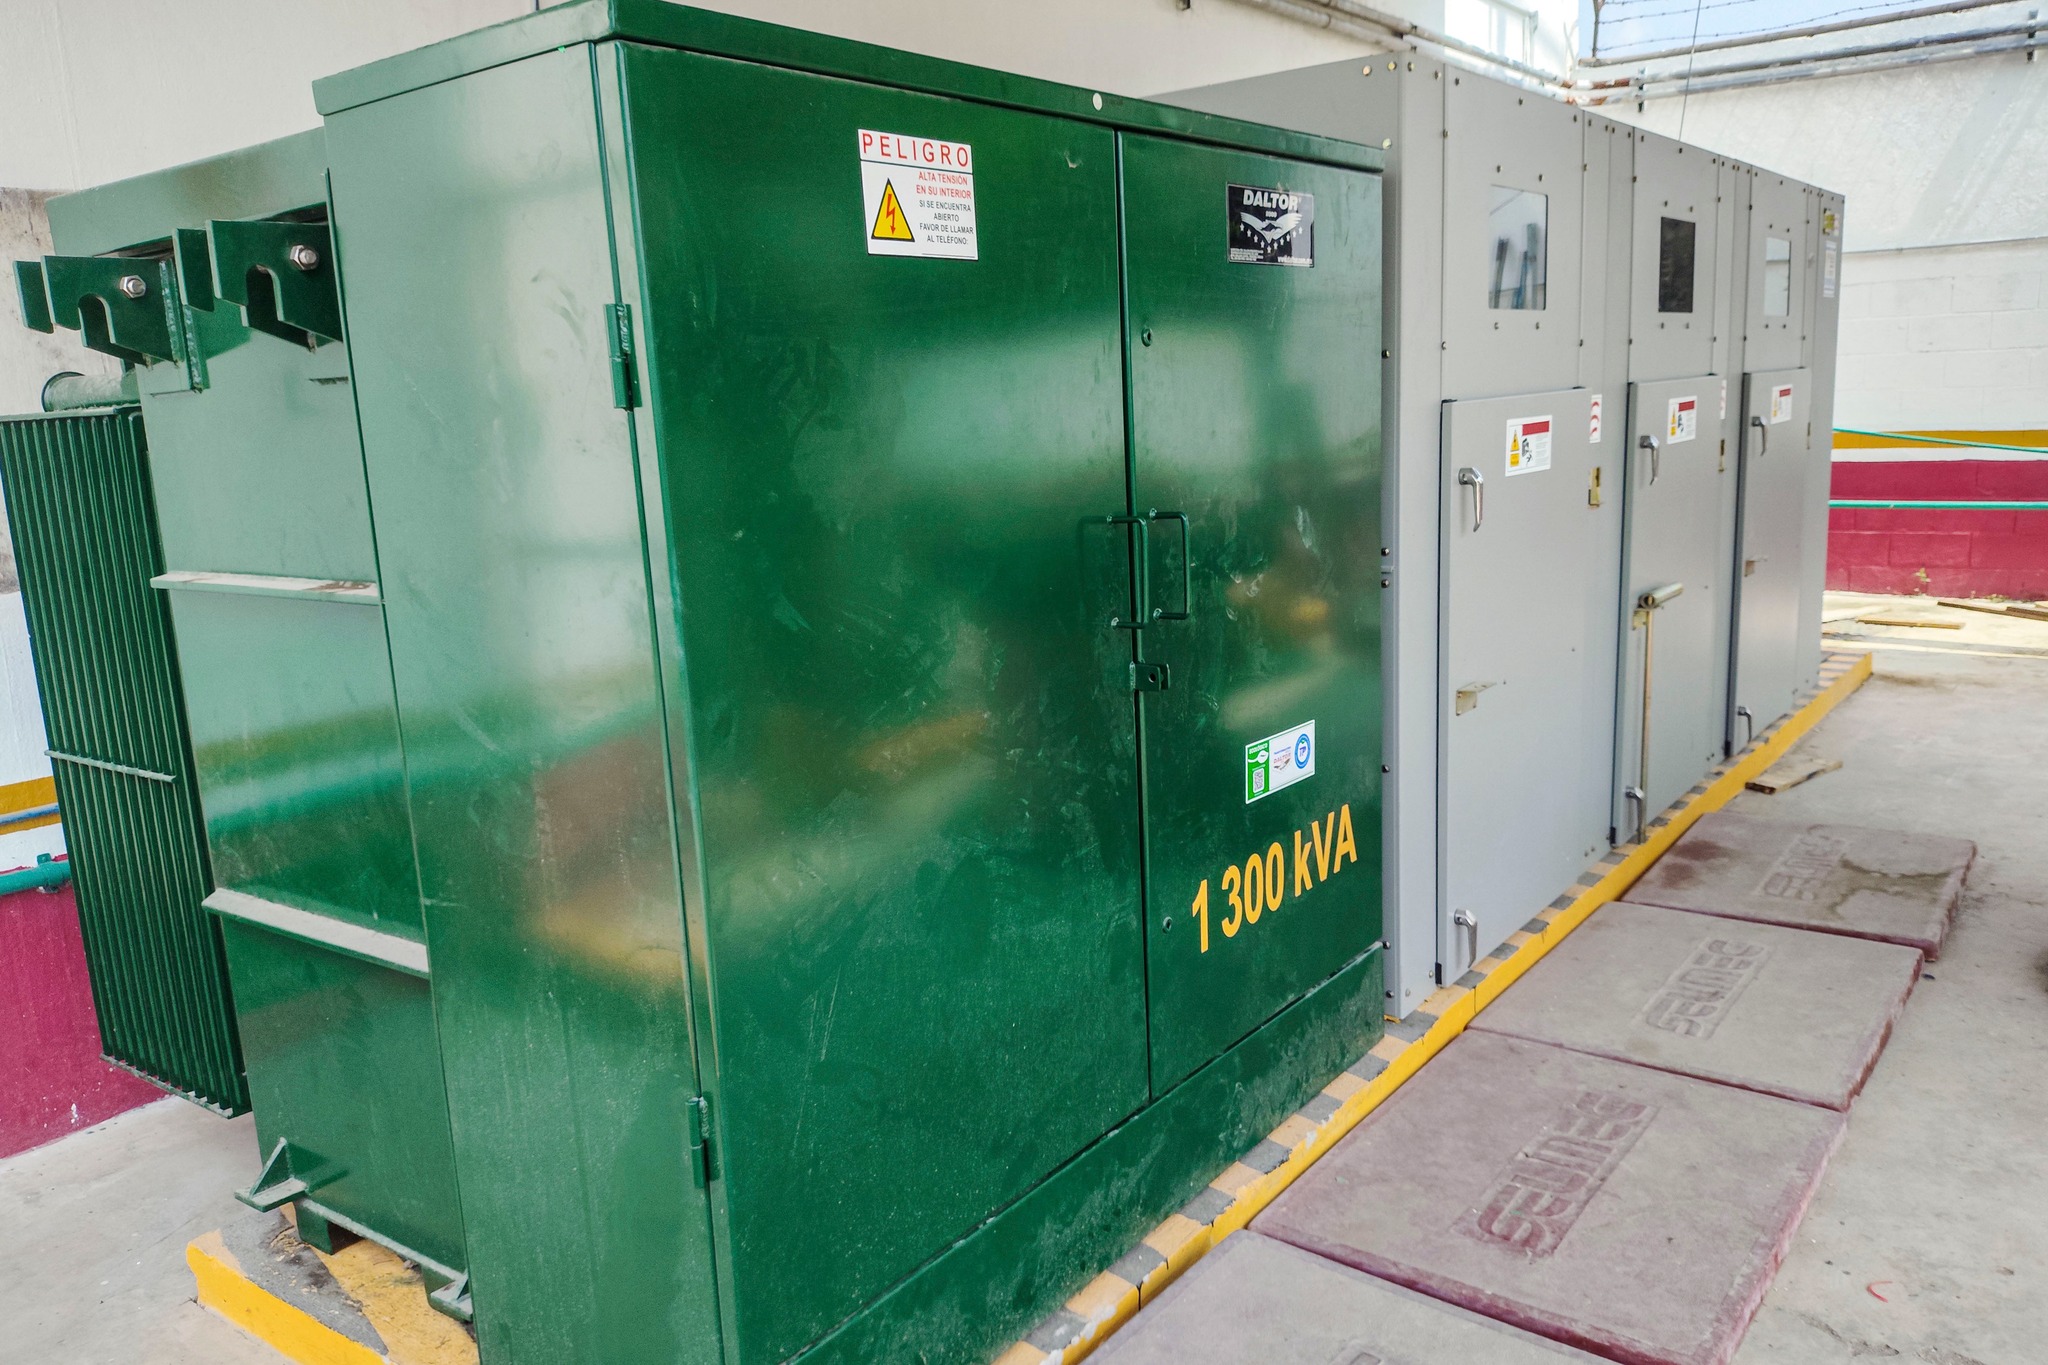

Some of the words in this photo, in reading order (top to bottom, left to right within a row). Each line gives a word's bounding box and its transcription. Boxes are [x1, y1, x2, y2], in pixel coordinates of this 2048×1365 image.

[862, 133, 969, 167] PELIGRO
[918, 171, 936, 181] ALTA
[937, 173, 968, 185] TENSIÓN
[916, 184, 927, 195] EN
[928, 186, 938, 196] SU
[939, 187, 972, 199] INTERIOR
[919, 199, 925, 208] SI
[926, 200, 935, 209] SE
[935, 201, 972, 212] ENCUENTRA
[1243, 189, 1298, 210] DALTOR
[933, 213, 959, 222] ABIERTO
[919, 223, 940, 232] FAVOR
[941, 224, 949, 233] DE
[950, 225, 974, 235] LLAMAR
[927, 235, 935, 243] AL
[936, 235, 969, 245] TELÉFONO:
[1192, 879, 1209, 953] 1
[1221, 842, 1285, 938] 300
[1294, 804, 1357, 897] kVA
